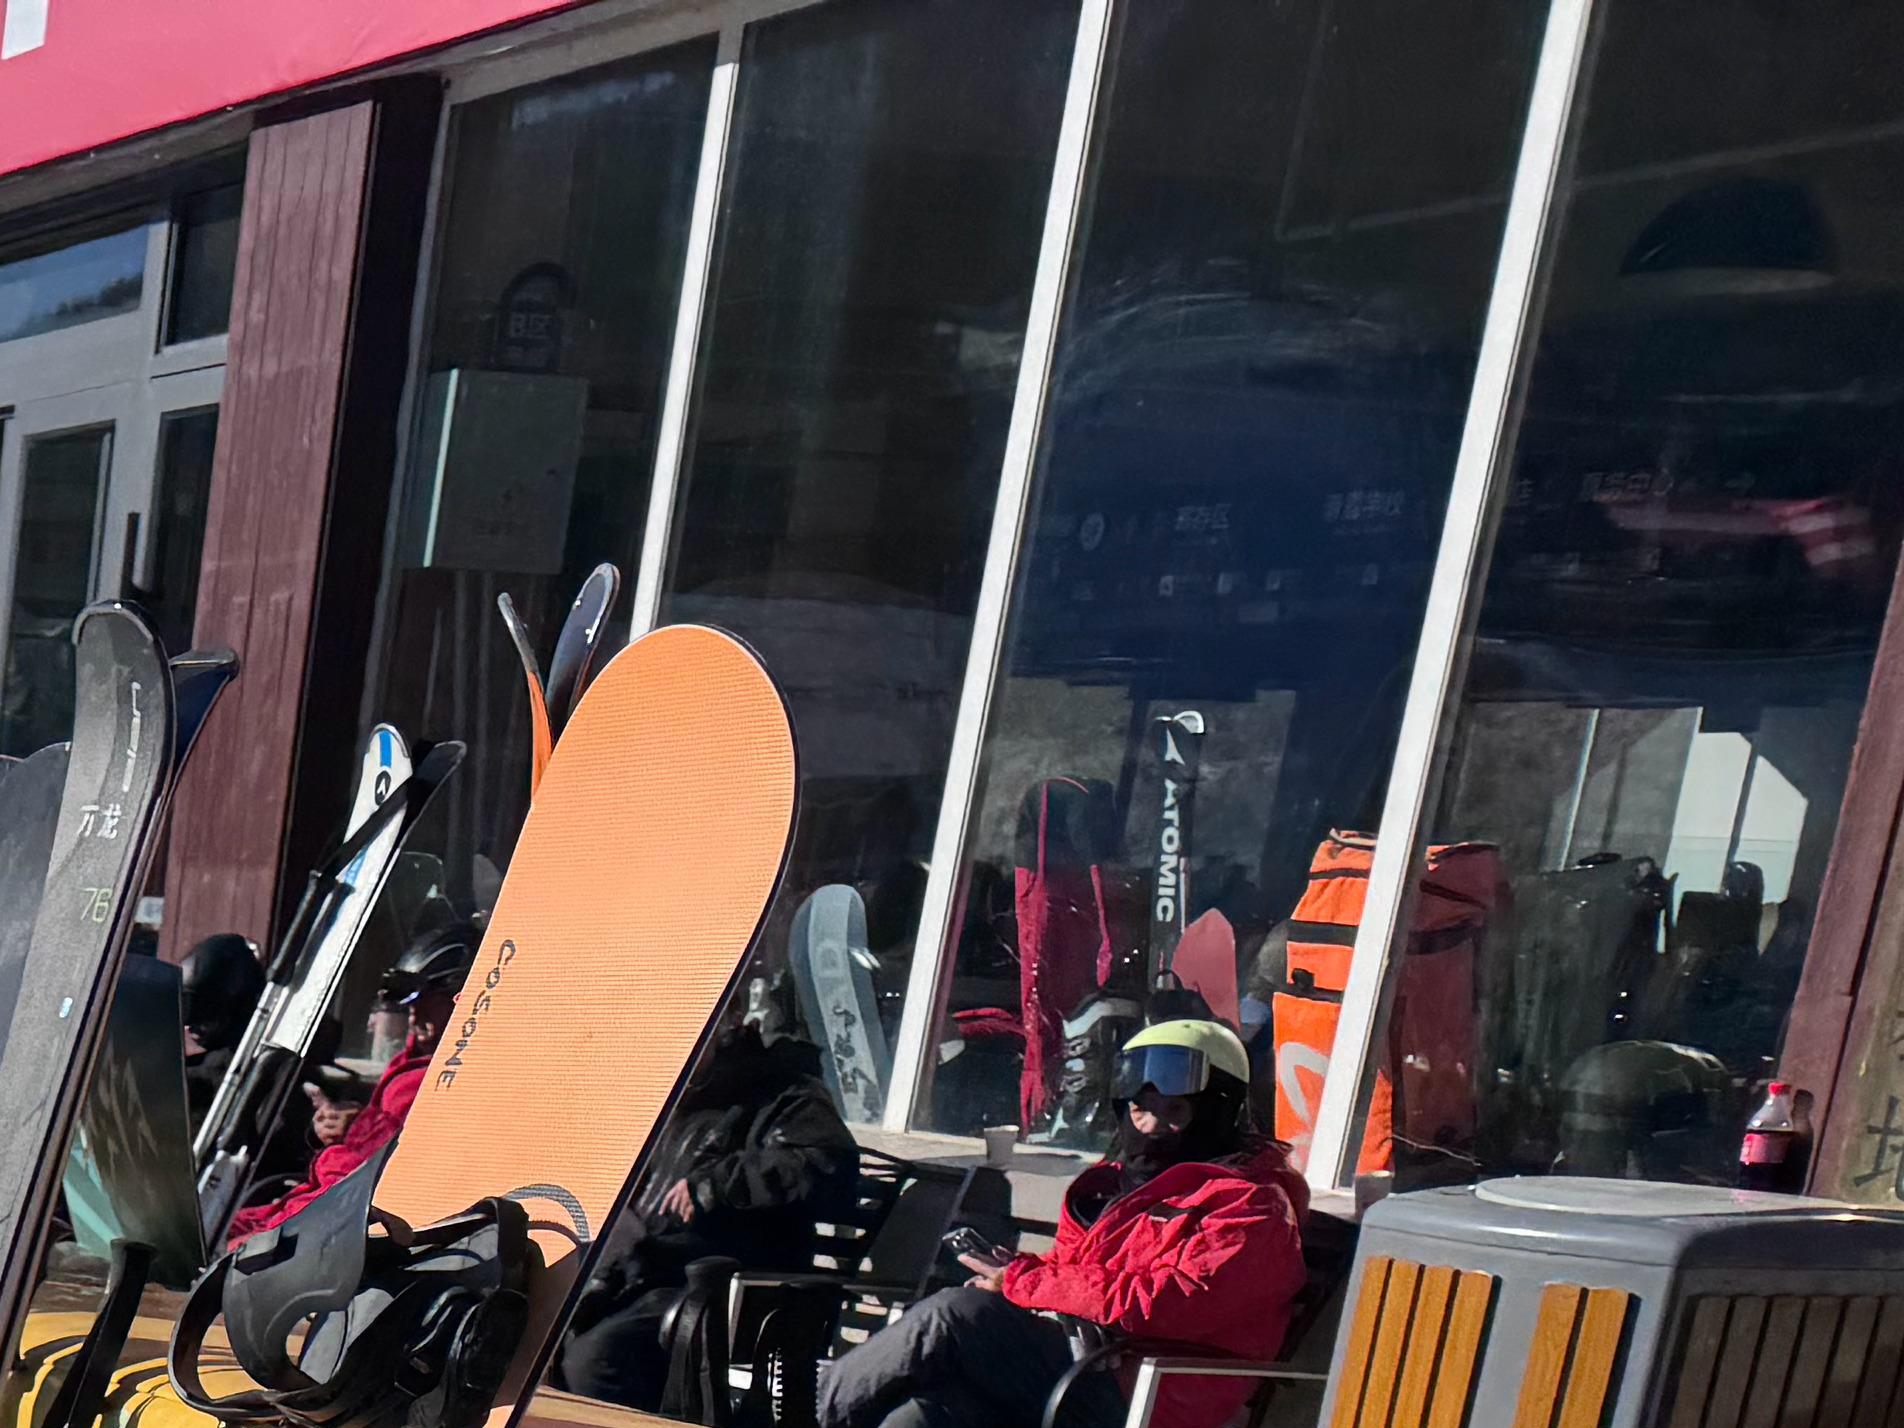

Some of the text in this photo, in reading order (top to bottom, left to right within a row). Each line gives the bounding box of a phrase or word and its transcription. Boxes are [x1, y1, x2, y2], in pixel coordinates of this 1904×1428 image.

[80, 887, 113, 923] 76
[1156, 778, 1180, 922] ATOMIC
[434, 939, 516, 1092] COSONE
